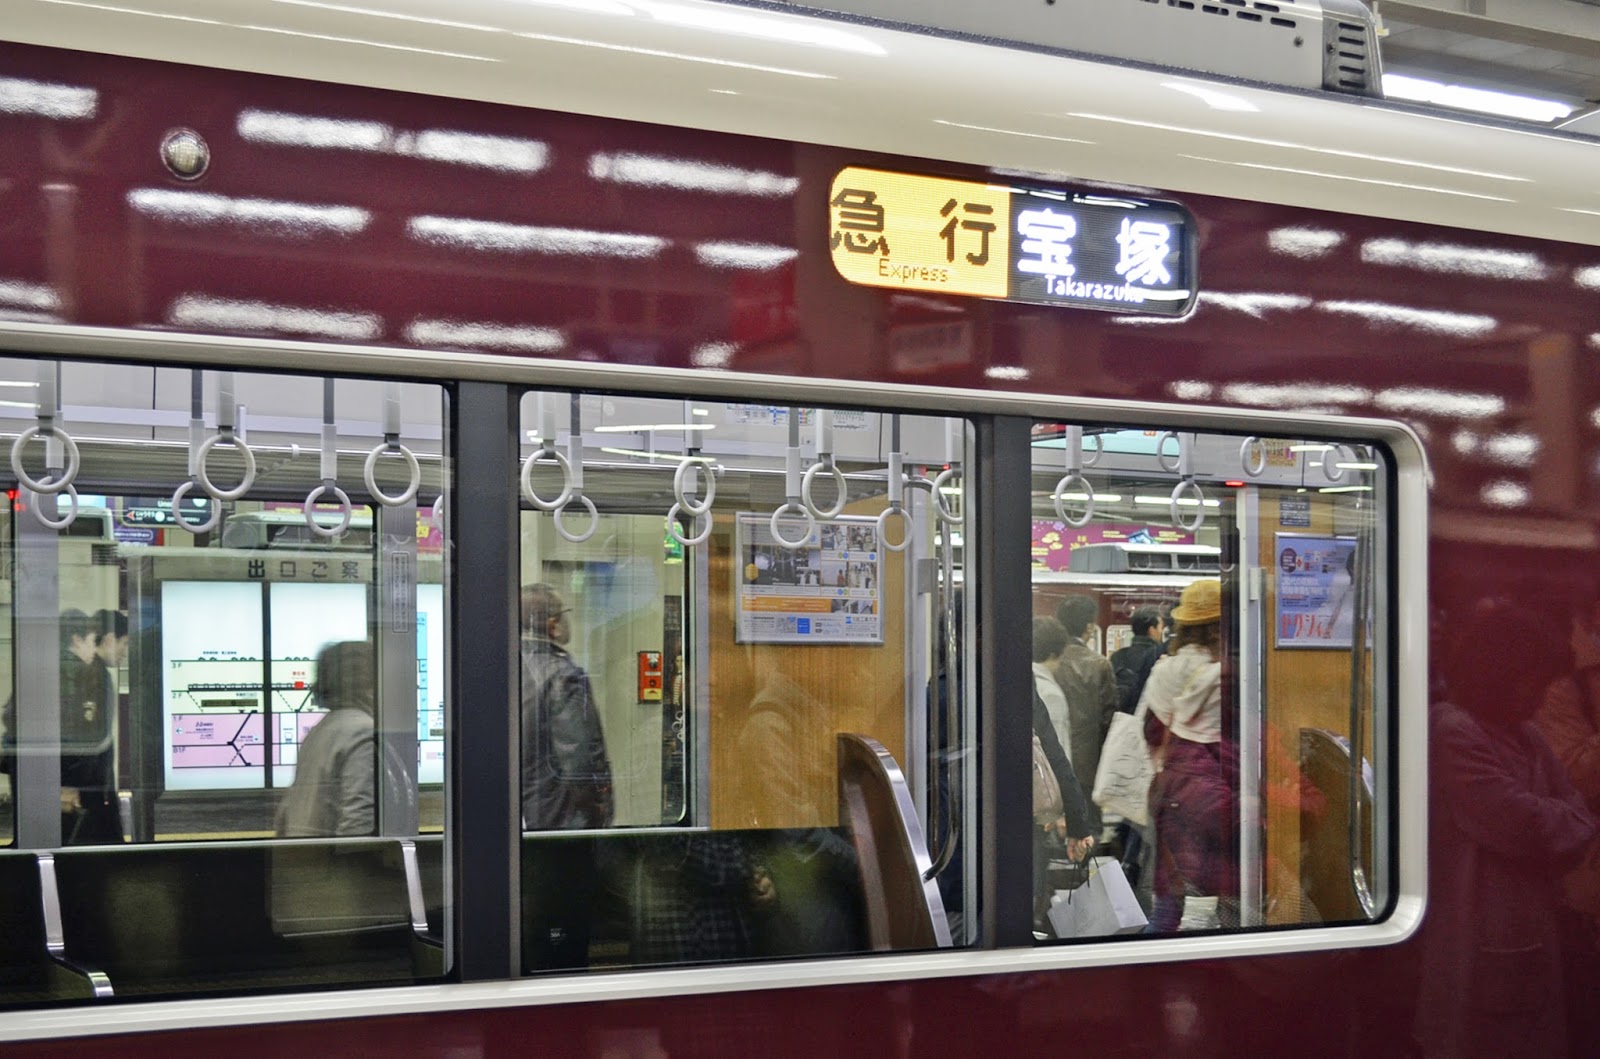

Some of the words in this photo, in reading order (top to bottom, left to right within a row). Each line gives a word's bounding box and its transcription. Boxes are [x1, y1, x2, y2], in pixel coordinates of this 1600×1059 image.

[830, 187, 997, 266] 急行
[1016, 207, 1172, 285] 宝塚
[879, 258, 949, 284] Express
